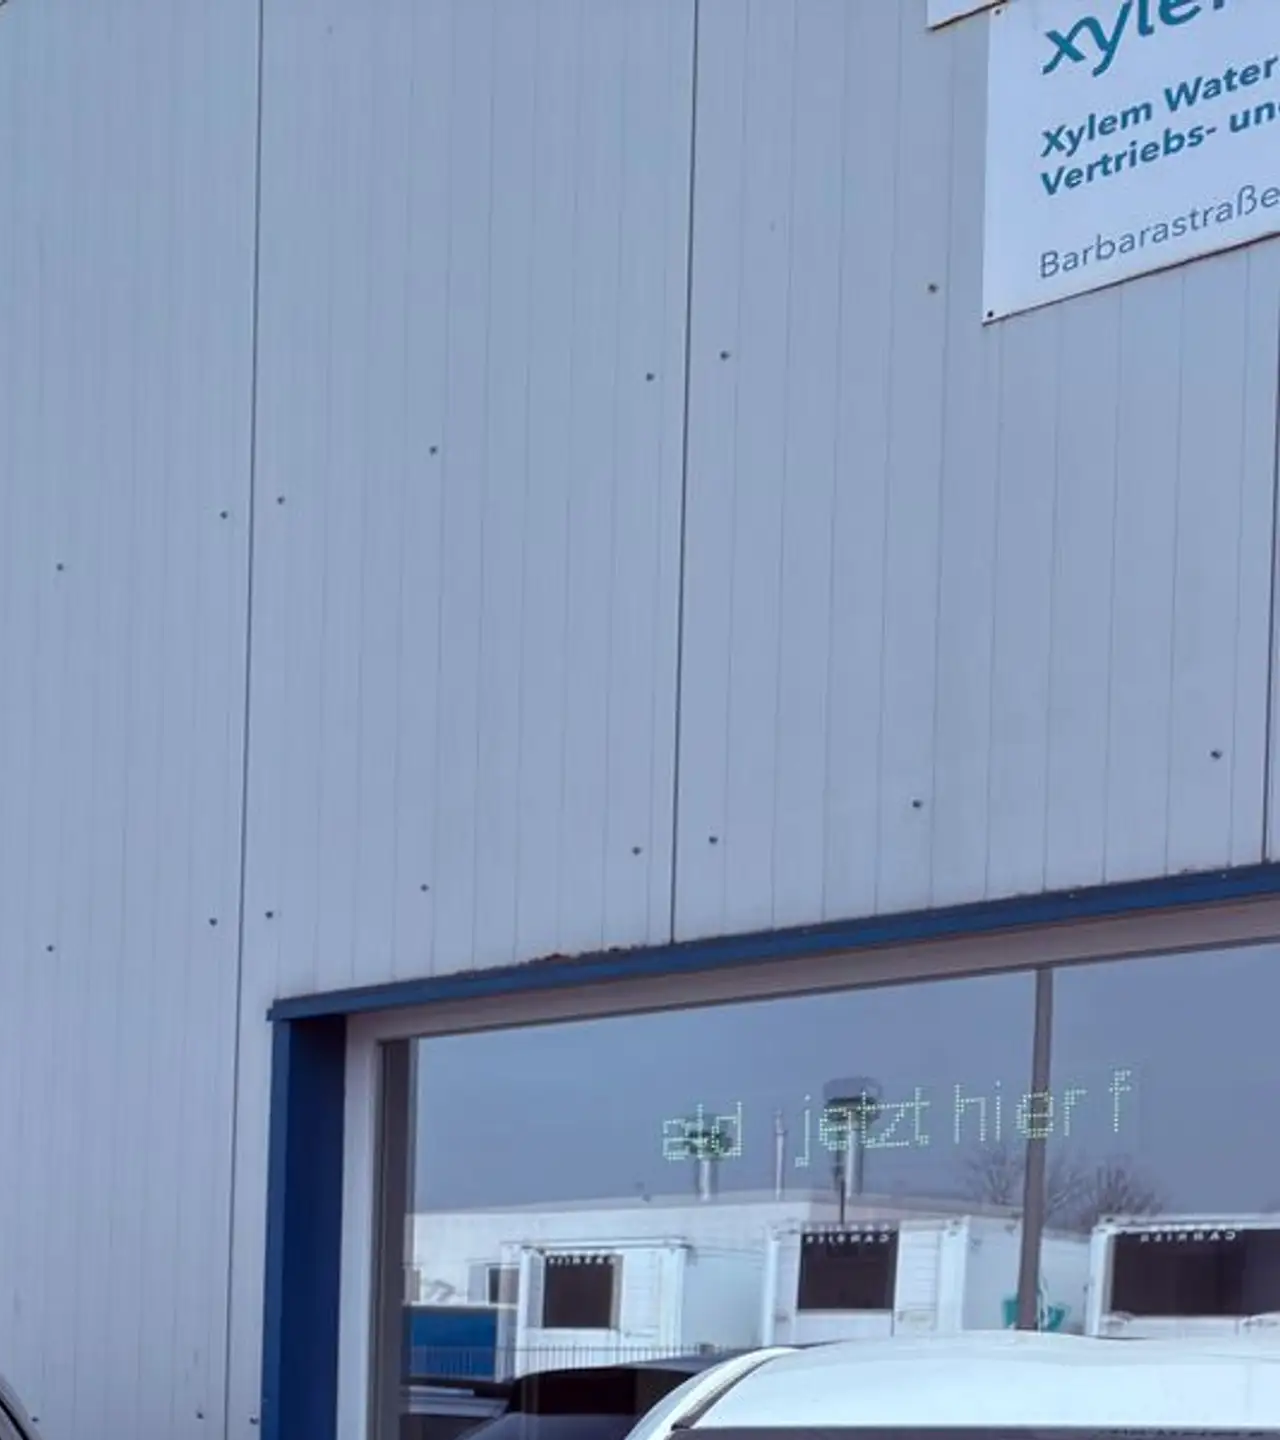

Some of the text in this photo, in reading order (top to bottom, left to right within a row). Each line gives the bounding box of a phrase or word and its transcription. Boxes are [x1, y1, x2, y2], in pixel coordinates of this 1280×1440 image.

[1042, 0, 1225, 77] xyle
[1040, 101, 1280, 196] Vertriebs- un
[1041, 56, 1278, 157] Xylem Water
[1040, 184, 1280, 279] Barbarastraße
